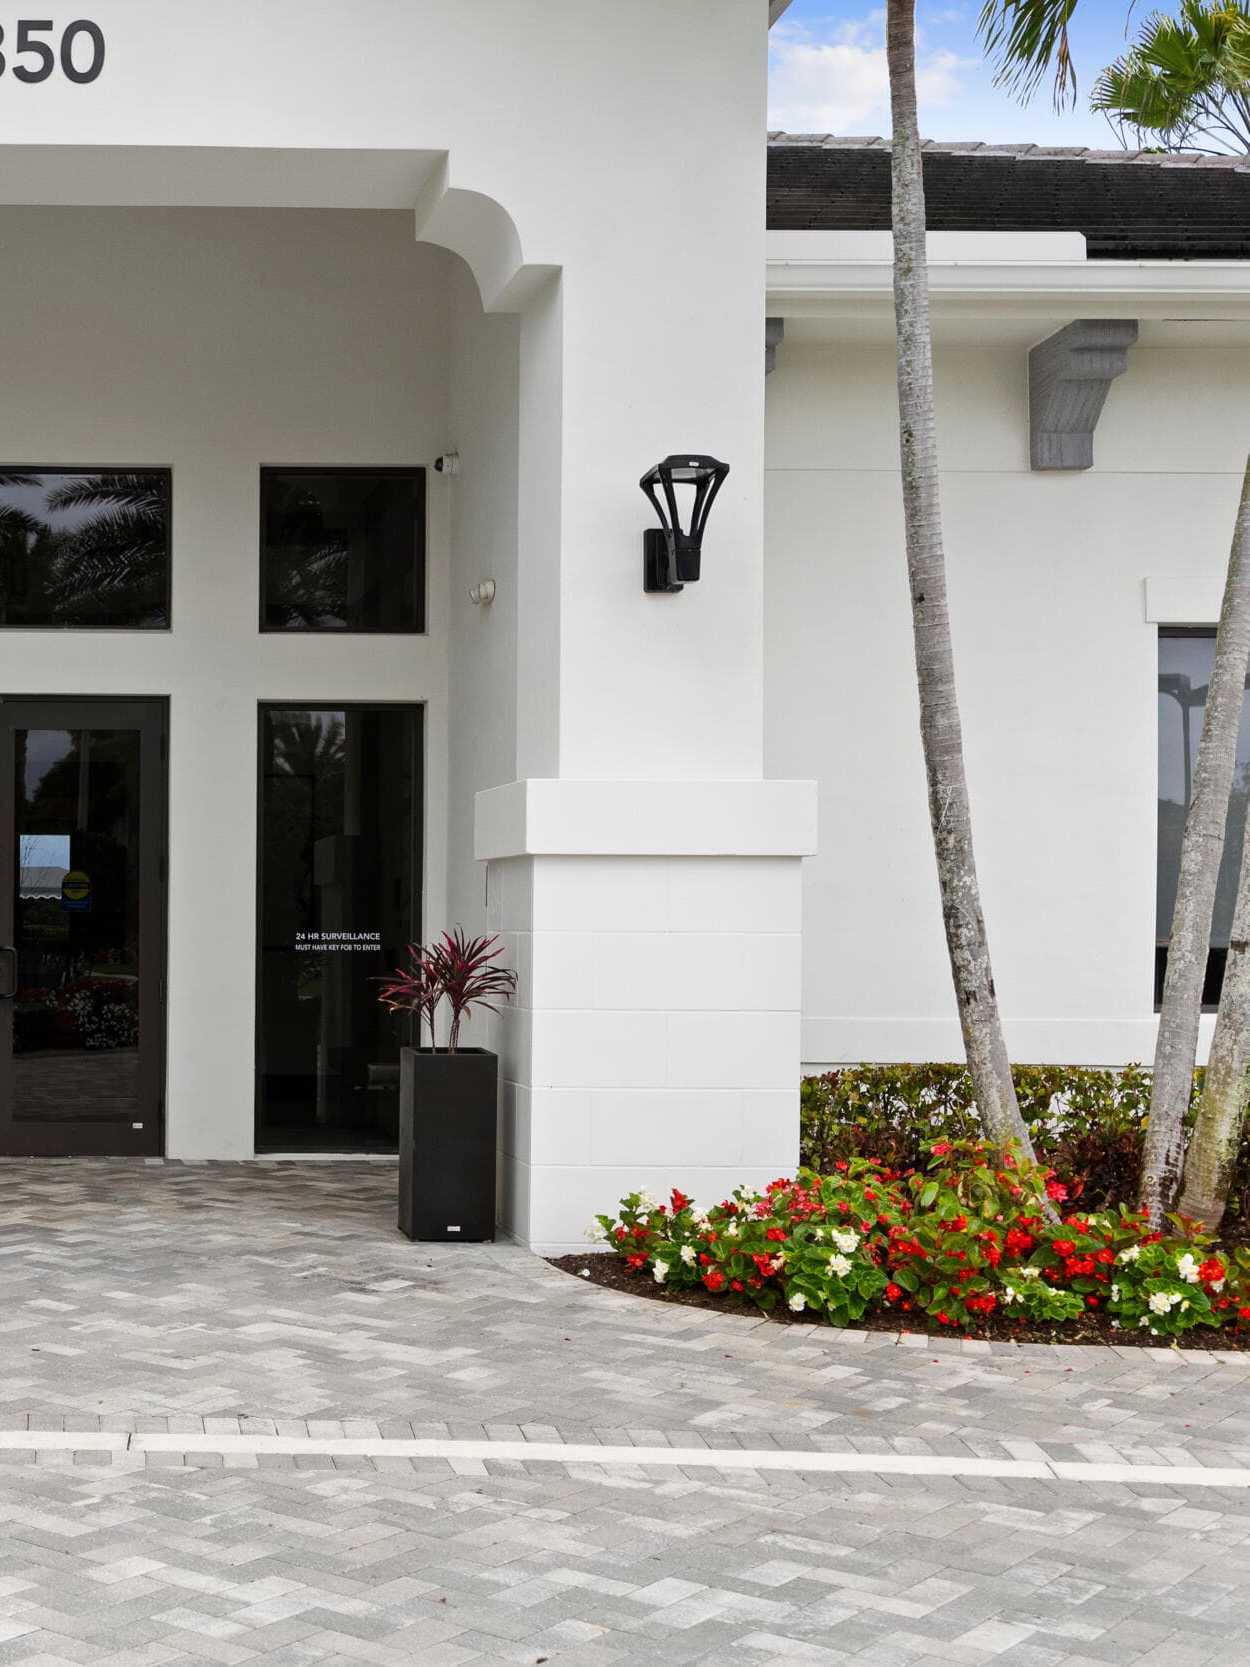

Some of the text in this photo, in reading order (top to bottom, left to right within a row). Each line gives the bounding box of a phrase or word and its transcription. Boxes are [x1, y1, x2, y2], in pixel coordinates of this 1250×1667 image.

[296, 932, 381, 940] 24 HR SURVEILLANCE
